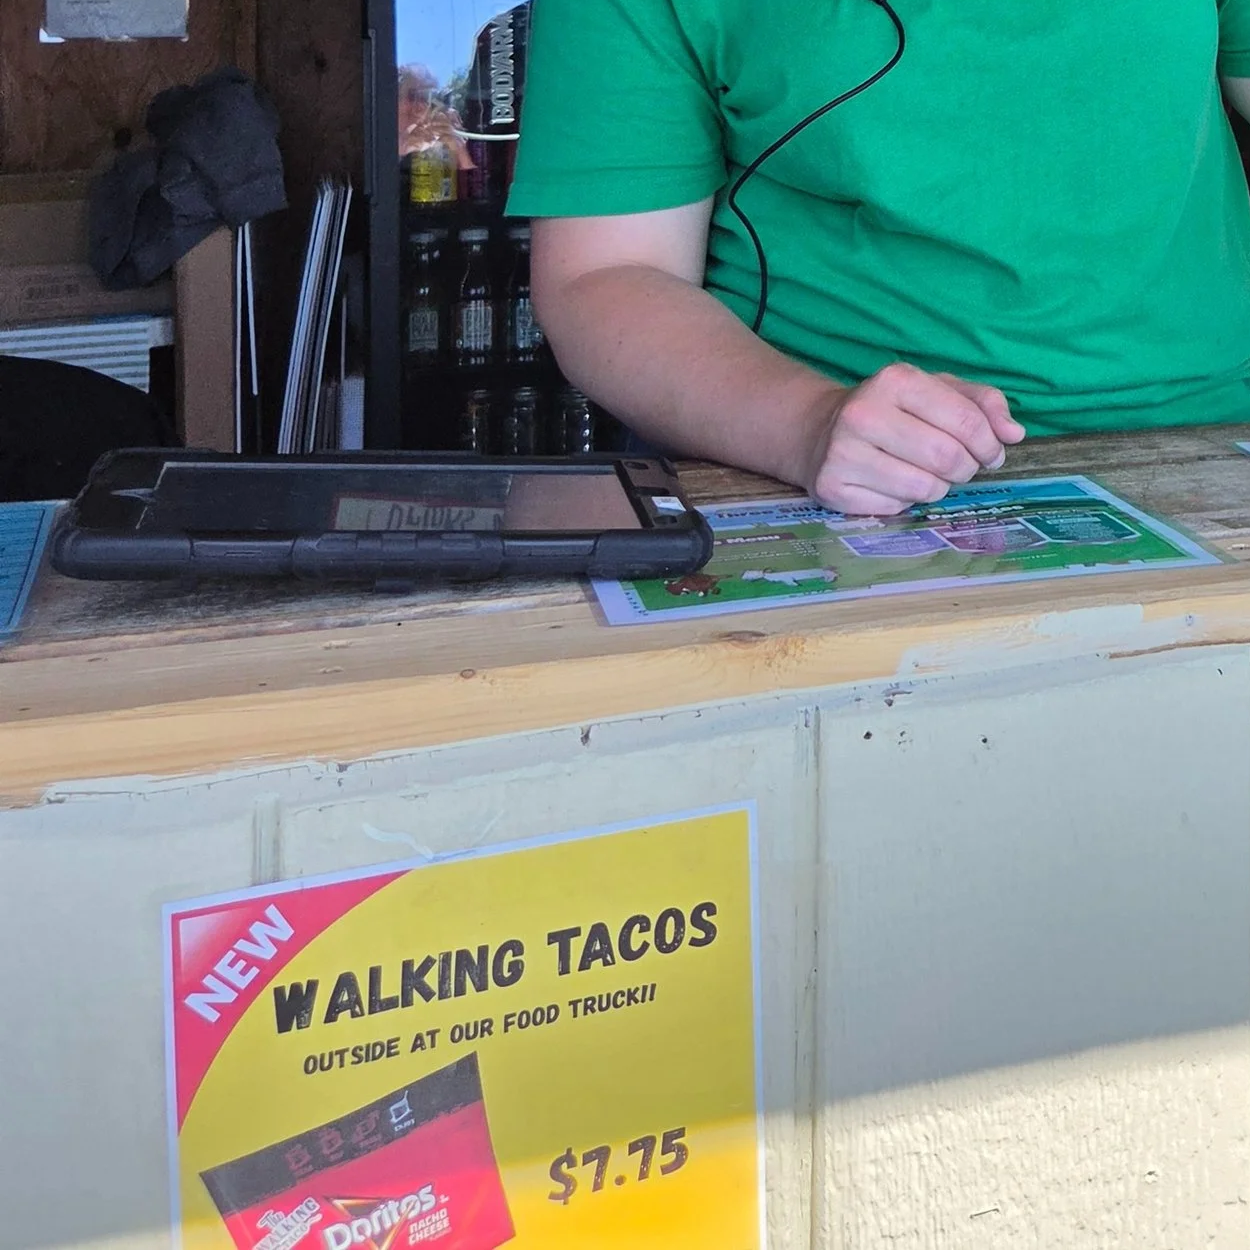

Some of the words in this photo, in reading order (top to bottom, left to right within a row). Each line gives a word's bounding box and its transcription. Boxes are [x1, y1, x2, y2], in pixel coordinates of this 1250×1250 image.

[184, 903, 295, 1025] NEW
[273, 938, 525, 1035] WALKING
[546, 901, 718, 977] TACOS
[303, 1036, 401, 1075] OUTSIDE
[410, 1028, 441, 1053] AT
[449, 1017, 495, 1042] OUR
[503, 1003, 561, 1034] FOOD
[569, 983, 657, 1020] TRUCK!!
[547, 1126, 690, 1206] $7.75
[323, 1183, 438, 1250] Doritos
[408, 1207, 449, 1235] NACHO
[408, 1218, 450, 1246] CHEESE
